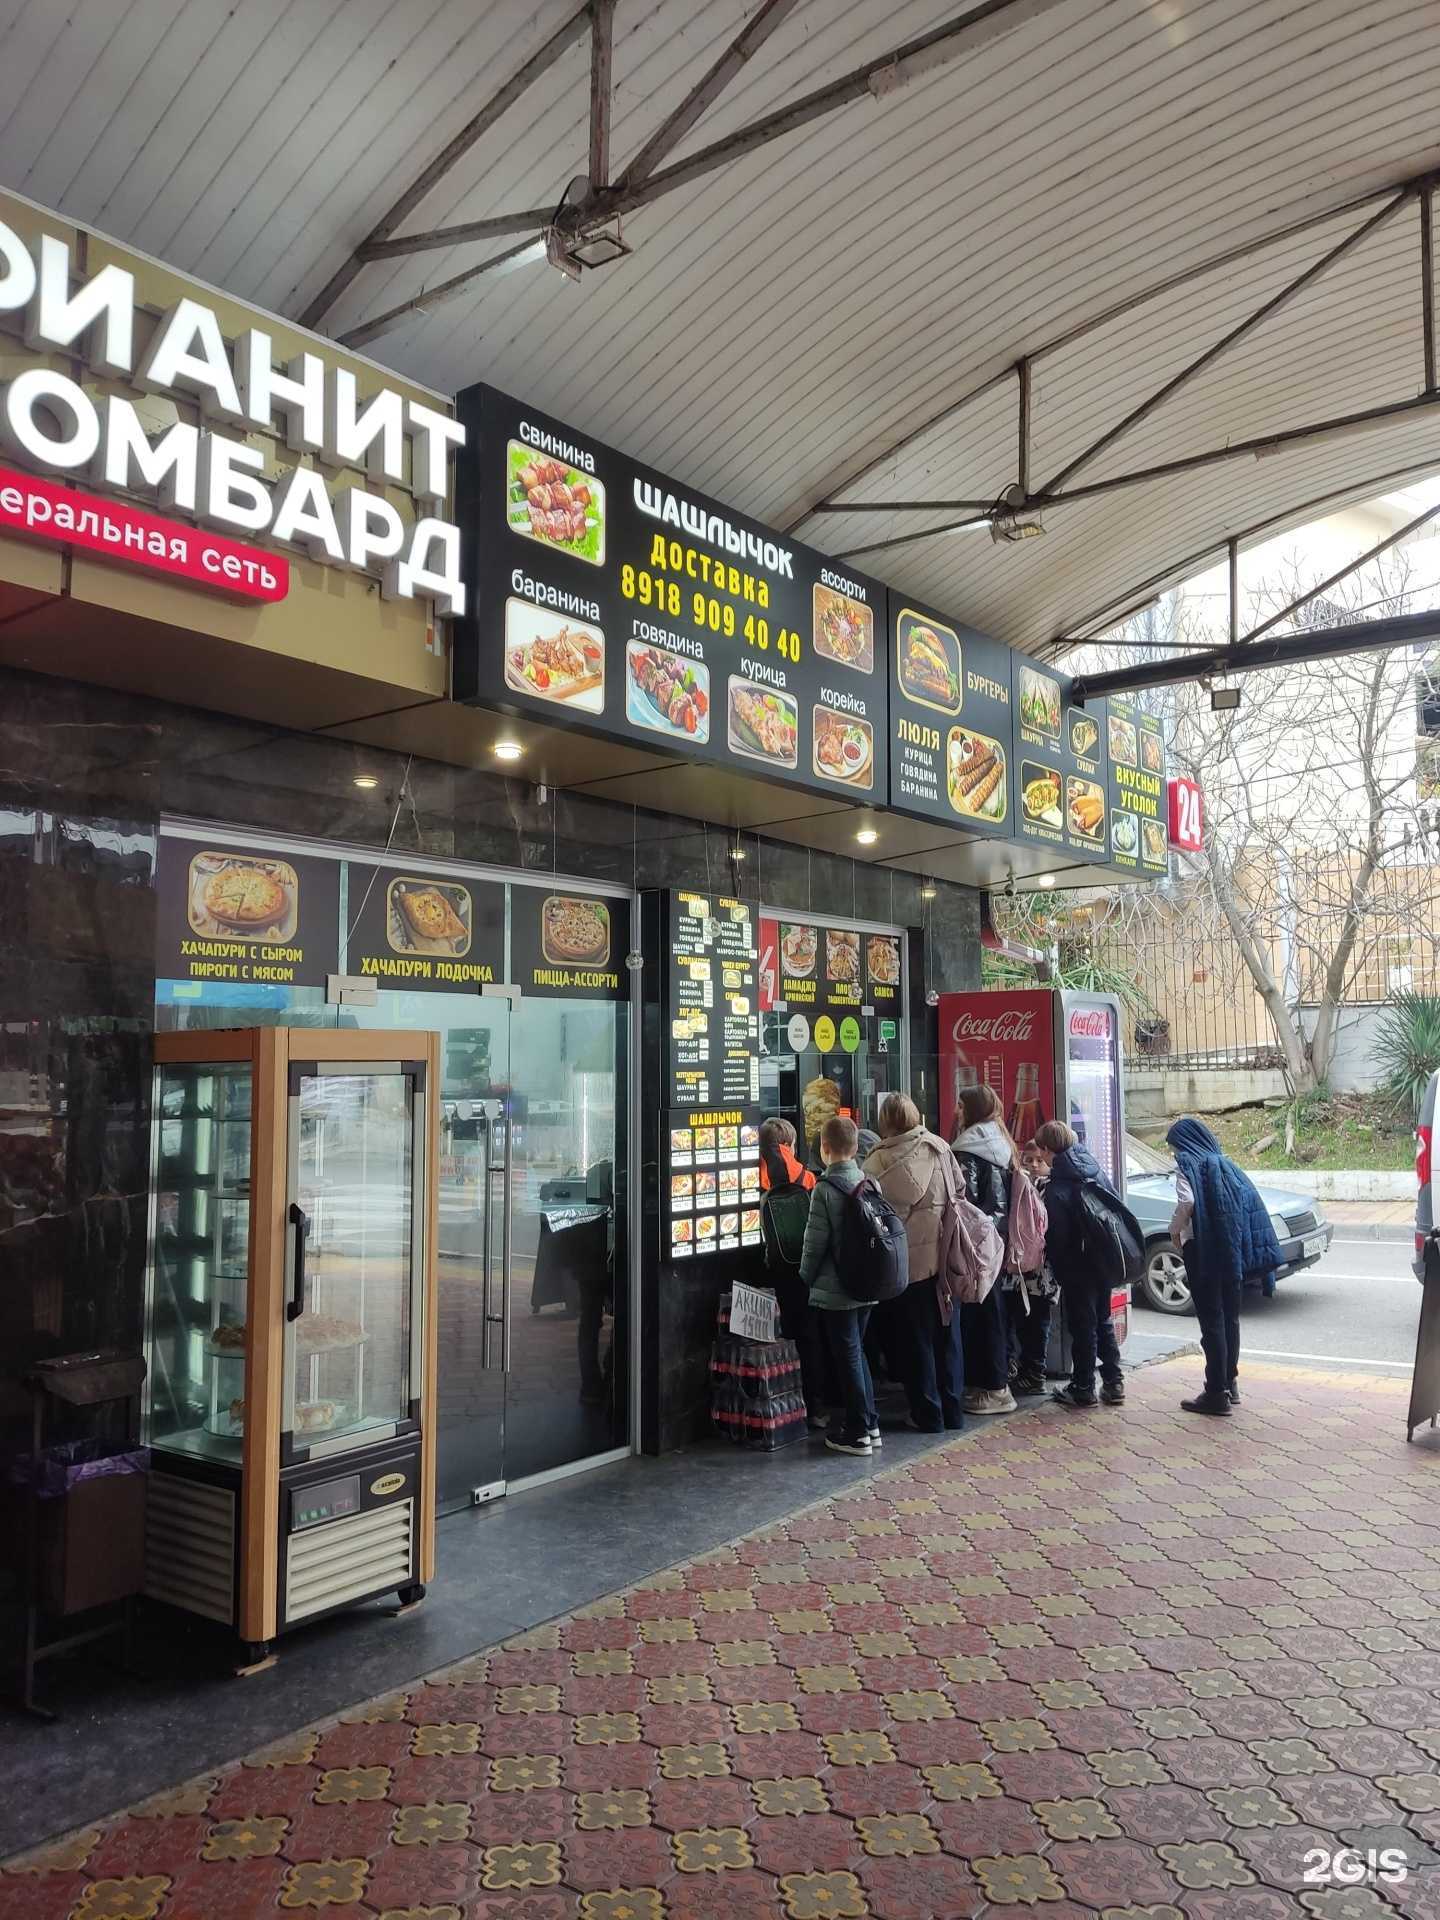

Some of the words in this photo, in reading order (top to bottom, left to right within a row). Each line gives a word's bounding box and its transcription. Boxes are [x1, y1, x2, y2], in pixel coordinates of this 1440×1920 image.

[519, 420, 596, 473] свинина
[634, 477, 794, 580] ШАШЛЫЧОК
[201, 543, 278, 591] сеть
[650, 532, 769, 609] доставка
[511, 567, 601, 622] баранина
[821, 567, 867, 601] ассорти
[621, 564, 682, 617] 8918
[693, 593, 735, 637] 909
[744, 614, 769, 650] 40
[777, 630, 801, 664] 40
[632, 618, 704, 659] говядина
[741, 656, 787, 689] курица
[967, 670, 1009, 705] БУРГЕРЫ
[820, 686, 866, 715] корейка
[898, 718, 940, 751] ЛЮЛЯ
[904, 746, 933, 766] КУРИЦА
[900, 762, 938, 784] ГОВЯДИНА
[1116, 764, 1161, 797] ВКУСНЫЙ
[901, 779, 938, 801] БАРАНИНА
[1120, 789, 1157, 816] УГОЛОК
[1179, 783, 1201, 845] 24
[180, 939, 246, 959] ХАЧАПУРИ
[250, 945, 259, 959] С
[261, 946, 303, 963] СЫРОМ
[189, 962, 238, 978] ПИРОГИ
[241, 963, 249, 979] С
[253, 964, 294, 981] МЯСОМ
[360, 957, 433, 978] ХАЧАПУРИ
[435, 962, 494, 983] ЛОДОЧКА
[533, 968, 618, 989] ПИЦЦА-АССОРТИ
[952, 1008, 1038, 1042] Coca-Cola
[689, 1111, 742, 1126] ШАШЛЫЧОК
[735, 1289, 772, 1320] АКЦИЯ
